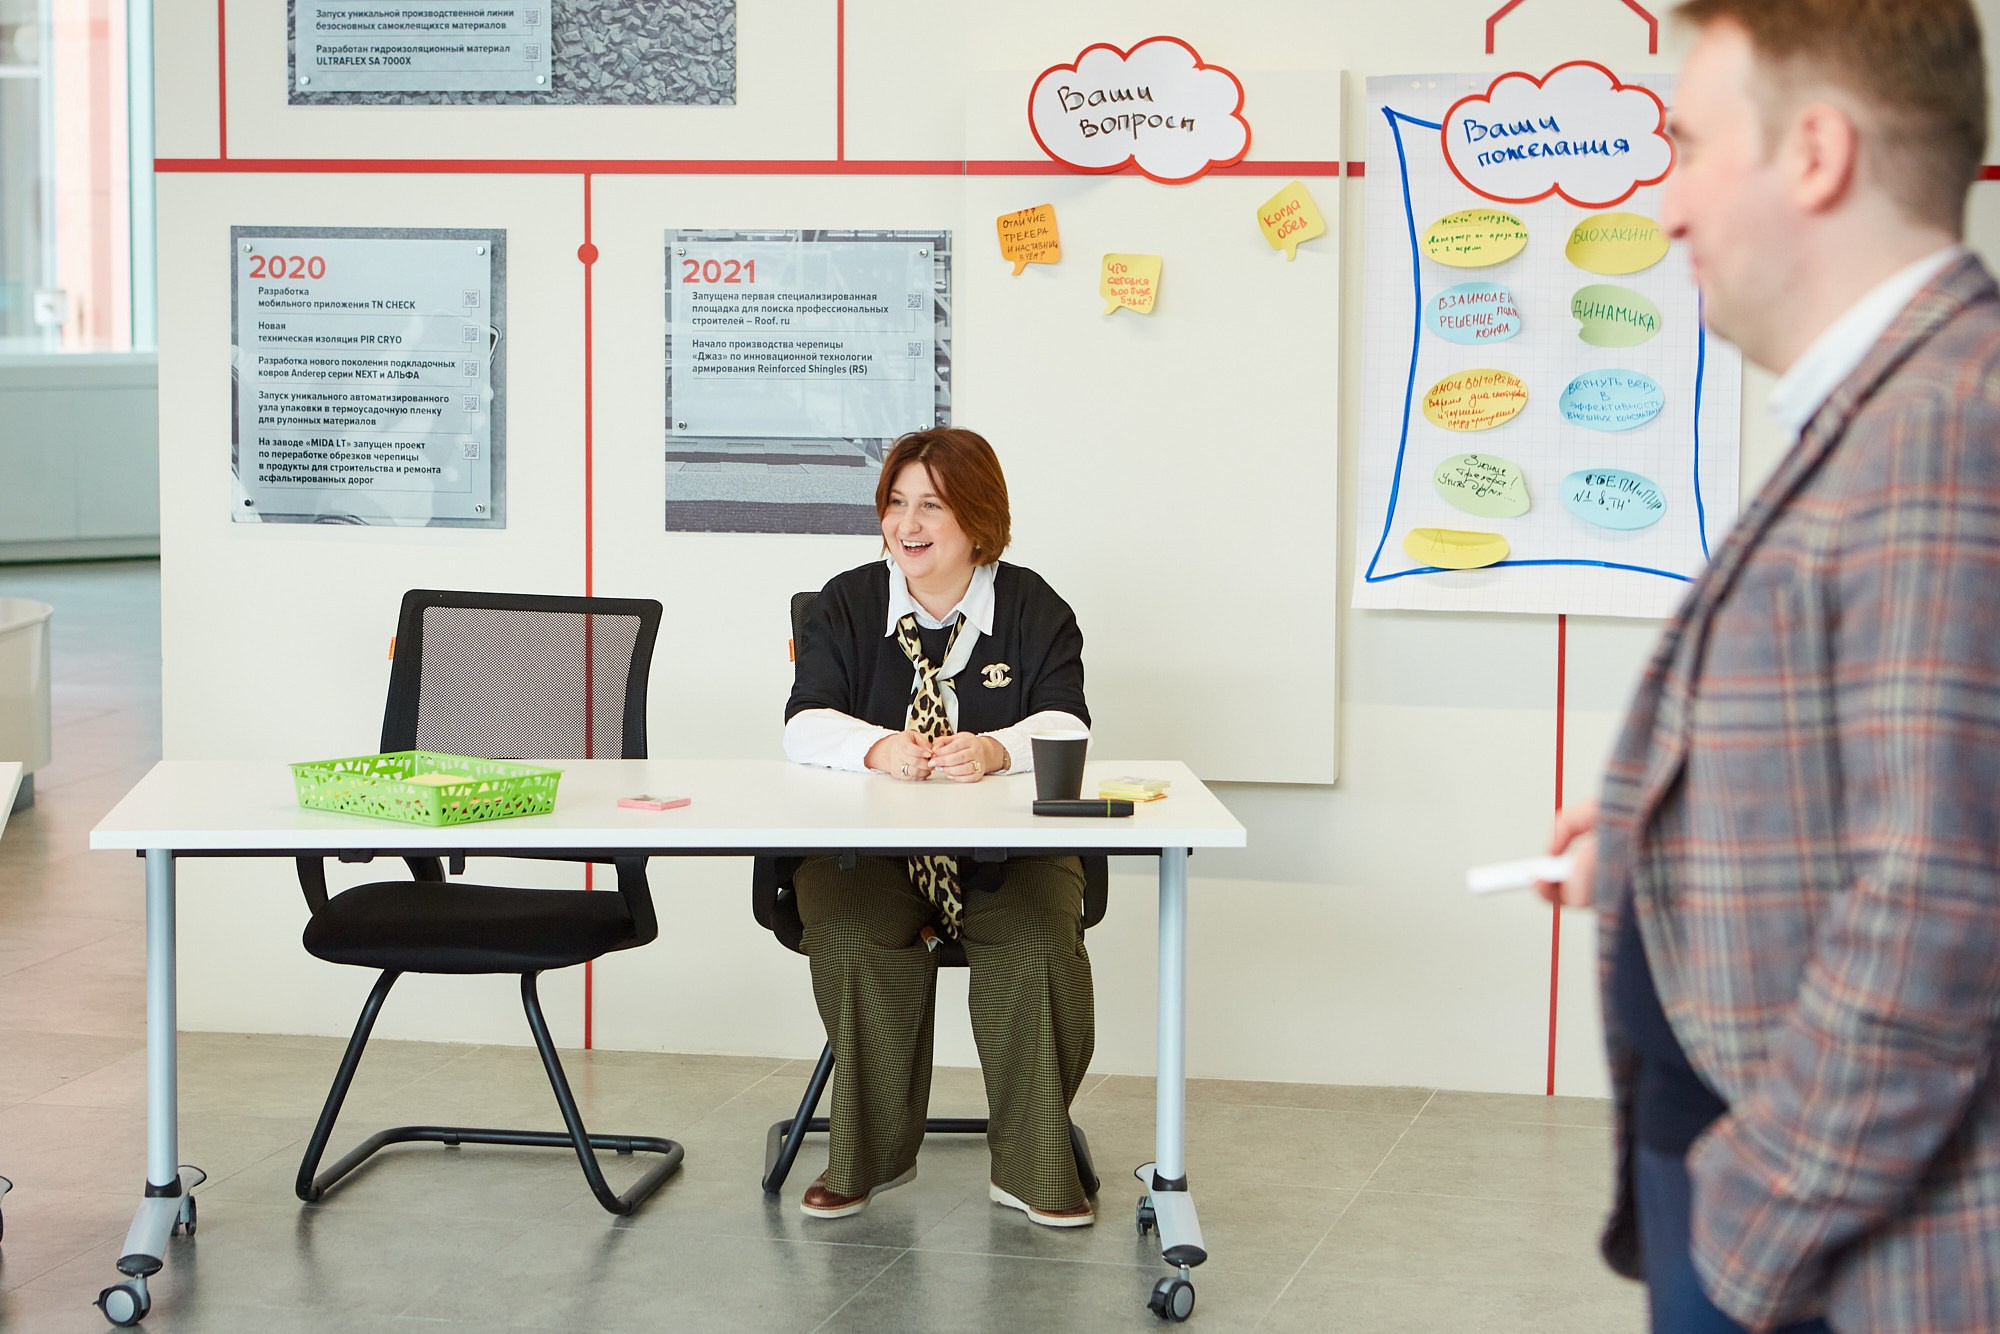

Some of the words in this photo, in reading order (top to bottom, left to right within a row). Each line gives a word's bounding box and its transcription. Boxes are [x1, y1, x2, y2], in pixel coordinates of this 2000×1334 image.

[316, 9, 346, 19] Запуск
[348, 9, 400, 19] уникальной
[402, 9, 484, 18] производственной
[487, 9, 514, 17] линии
[316, 22, 375, 30] безосновных
[377, 22, 450, 31] самоклеящихся
[452, 22, 507, 30] материалов
[316, 45, 368, 55] Разработан
[370, 44, 464, 54] гидроизоляционный
[467, 45, 510, 54] материал
[316, 57, 366, 66] ULTRAFLEX
[368, 57, 380, 65] SA
[383, 57, 411, 65] 7000X
[1057, 85, 1154, 113] Ваши
[1463, 115, 1560, 144] Ваши
[1478, 137, 1630, 168] пожелания
[1003, 227, 1049, 242] ТРЕКЕРА
[1573, 227, 1659, 245] БИОХАКИНГ
[248, 255, 327, 280] 2020
[682, 259, 756, 284] 2021
[258, 287, 309, 297] Разработка
[692, 291, 739, 302] Запущена
[741, 293, 775, 302] первая
[777, 292, 877, 302] специализированная
[258, 299, 312, 308] мобильного
[313, 299, 370, 309] приложения
[371, 300, 383, 309] TN
[385, 300, 416, 310] CHECK
[692, 305, 739, 314] площадка
[741, 305, 759, 314] для
[761, 305, 794, 313] поиска
[796, 304, 889, 315] профессиональных
[692, 316, 744, 327] строителей
[754, 316, 779, 326] Roof.
[780, 318, 790, 326] ru
[1439, 313, 1494, 329] РЕШЕНИЕ
[1573, 300, 1655, 332] ДИНАМИКА
[258, 321, 286, 331] Новая
[258, 335, 313, 344] техническая
[315, 335, 358, 344] изоляция
[360, 334, 375, 344] PIR
[377, 335, 402, 344] CRYO
[692, 339, 727, 349] Начало
[729, 340, 794, 350] производства
[796, 341, 843, 350] черепицы
[692, 352, 728, 362] «Джаз»
[743, 352, 818, 361] инновационной
[819, 353, 873, 362] технологии
[258, 357, 308, 367] Разработка
[310, 358, 340, 366] нового
[341, 359, 388, 367] поколения
[390, 360, 455, 369] подкладочных
[258, 369, 290, 379] ковров
[291, 369, 327, 380] Anderep
[328, 371, 353, 379] серии
[355, 370, 377, 379] NEXT
[387, 370, 420, 379] АЛЬФА
[692, 365, 755, 375] армирования
[757, 364, 807, 374] Reinforced
[808, 364, 847, 375] Shingles
[848, 364, 868, 375] (RS)
[258, 391, 289, 401] Запуск
[290, 393, 348, 402] уникального
[350, 394, 450, 403] автоматизированного
[258, 405, 278, 414] узла
[280, 405, 323, 414] упаковки
[332, 406, 408, 415] термоусадочную
[410, 407, 442, 416] пленку
[258, 416, 275, 425] для
[276, 417, 321, 426] рулонных
[323, 418, 376, 427] материалов
[258, 437, 270, 447] На
[272, 439, 304, 449] заводе
[305, 438, 334, 448] «MIDA
[336, 439, 352, 448] LT»
[353, 441, 393, 450] запущен
[395, 442, 426, 451] проект
[258, 451, 270, 459] по
[271, 451, 328, 461] переработке
[329, 452, 372, 462] обрезков
[374, 453, 419, 463] черепицы
[266, 463, 310, 473] продукты
[312, 464, 329, 473] для
[330, 464, 394, 474] строительства
[403, 466, 441, 475] ремонта
[259, 473, 346, 485] асфальтированных
[348, 476, 374, 485] дорог
